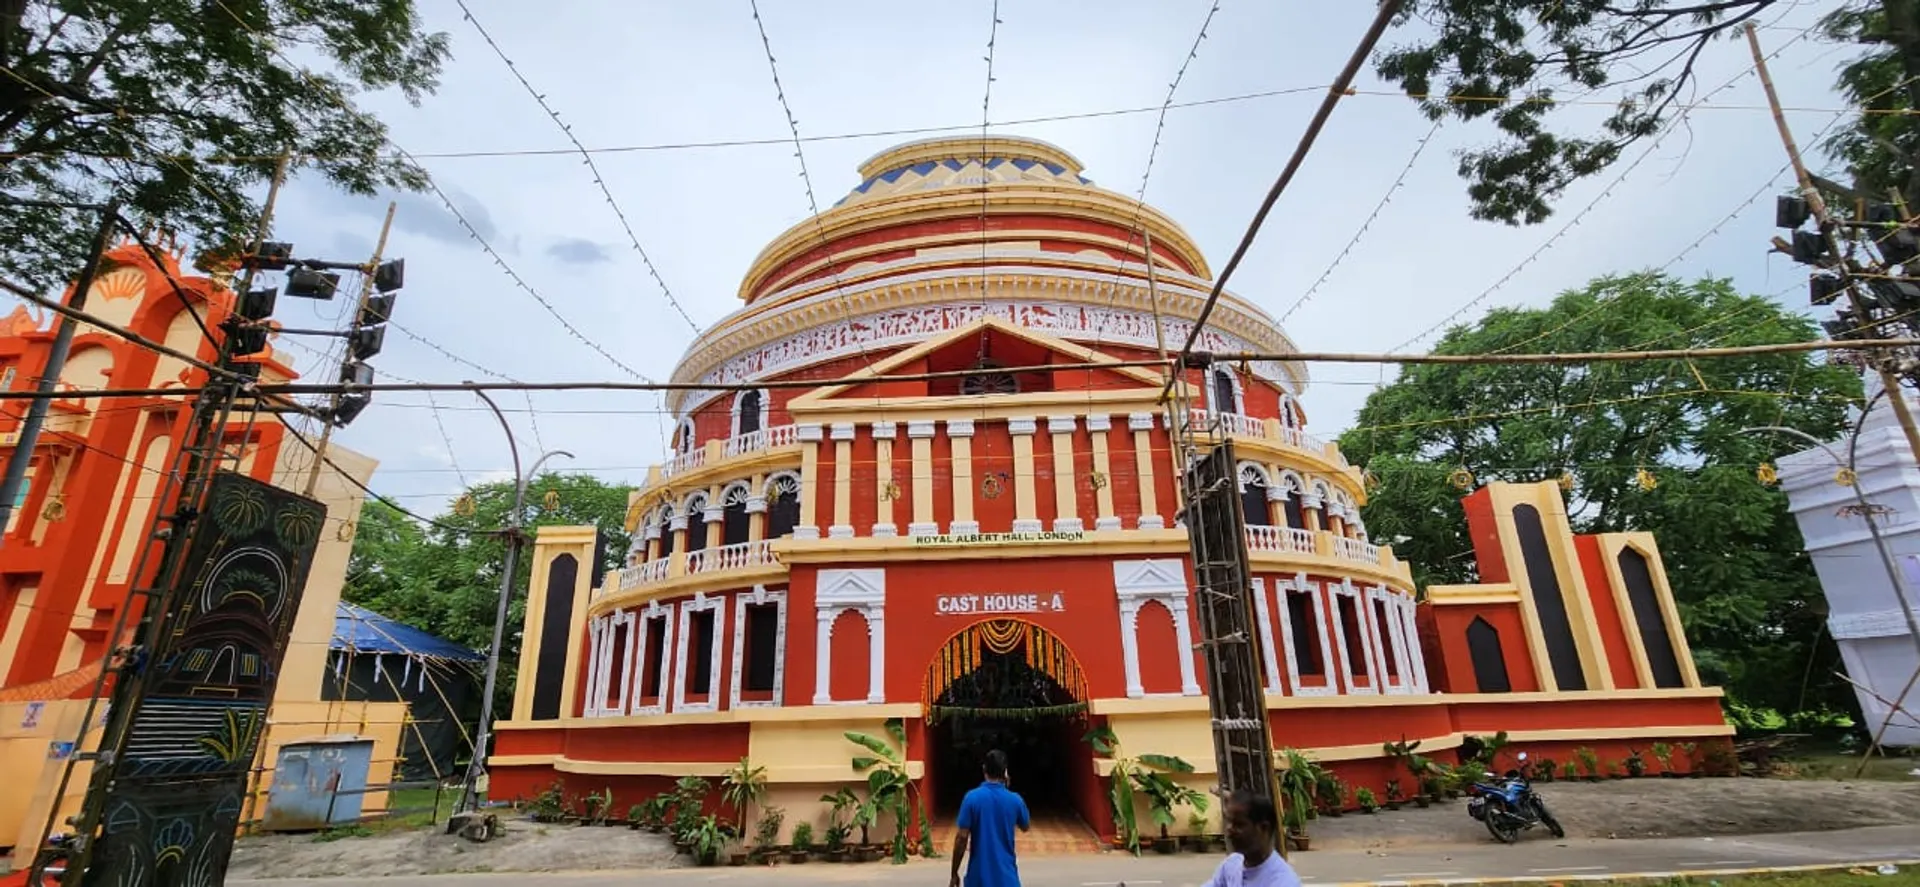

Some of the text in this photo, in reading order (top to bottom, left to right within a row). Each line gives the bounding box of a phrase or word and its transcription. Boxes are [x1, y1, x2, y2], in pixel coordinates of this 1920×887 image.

[916, 535, 952, 544] ROYAL
[956, 533, 998, 543] ALBERT
[1037, 531, 1083, 541] LONDON
[938, 595, 979, 612] CAST
[983, 594, 1037, 611] HOUSE
[1051, 593, 1064, 610] A
